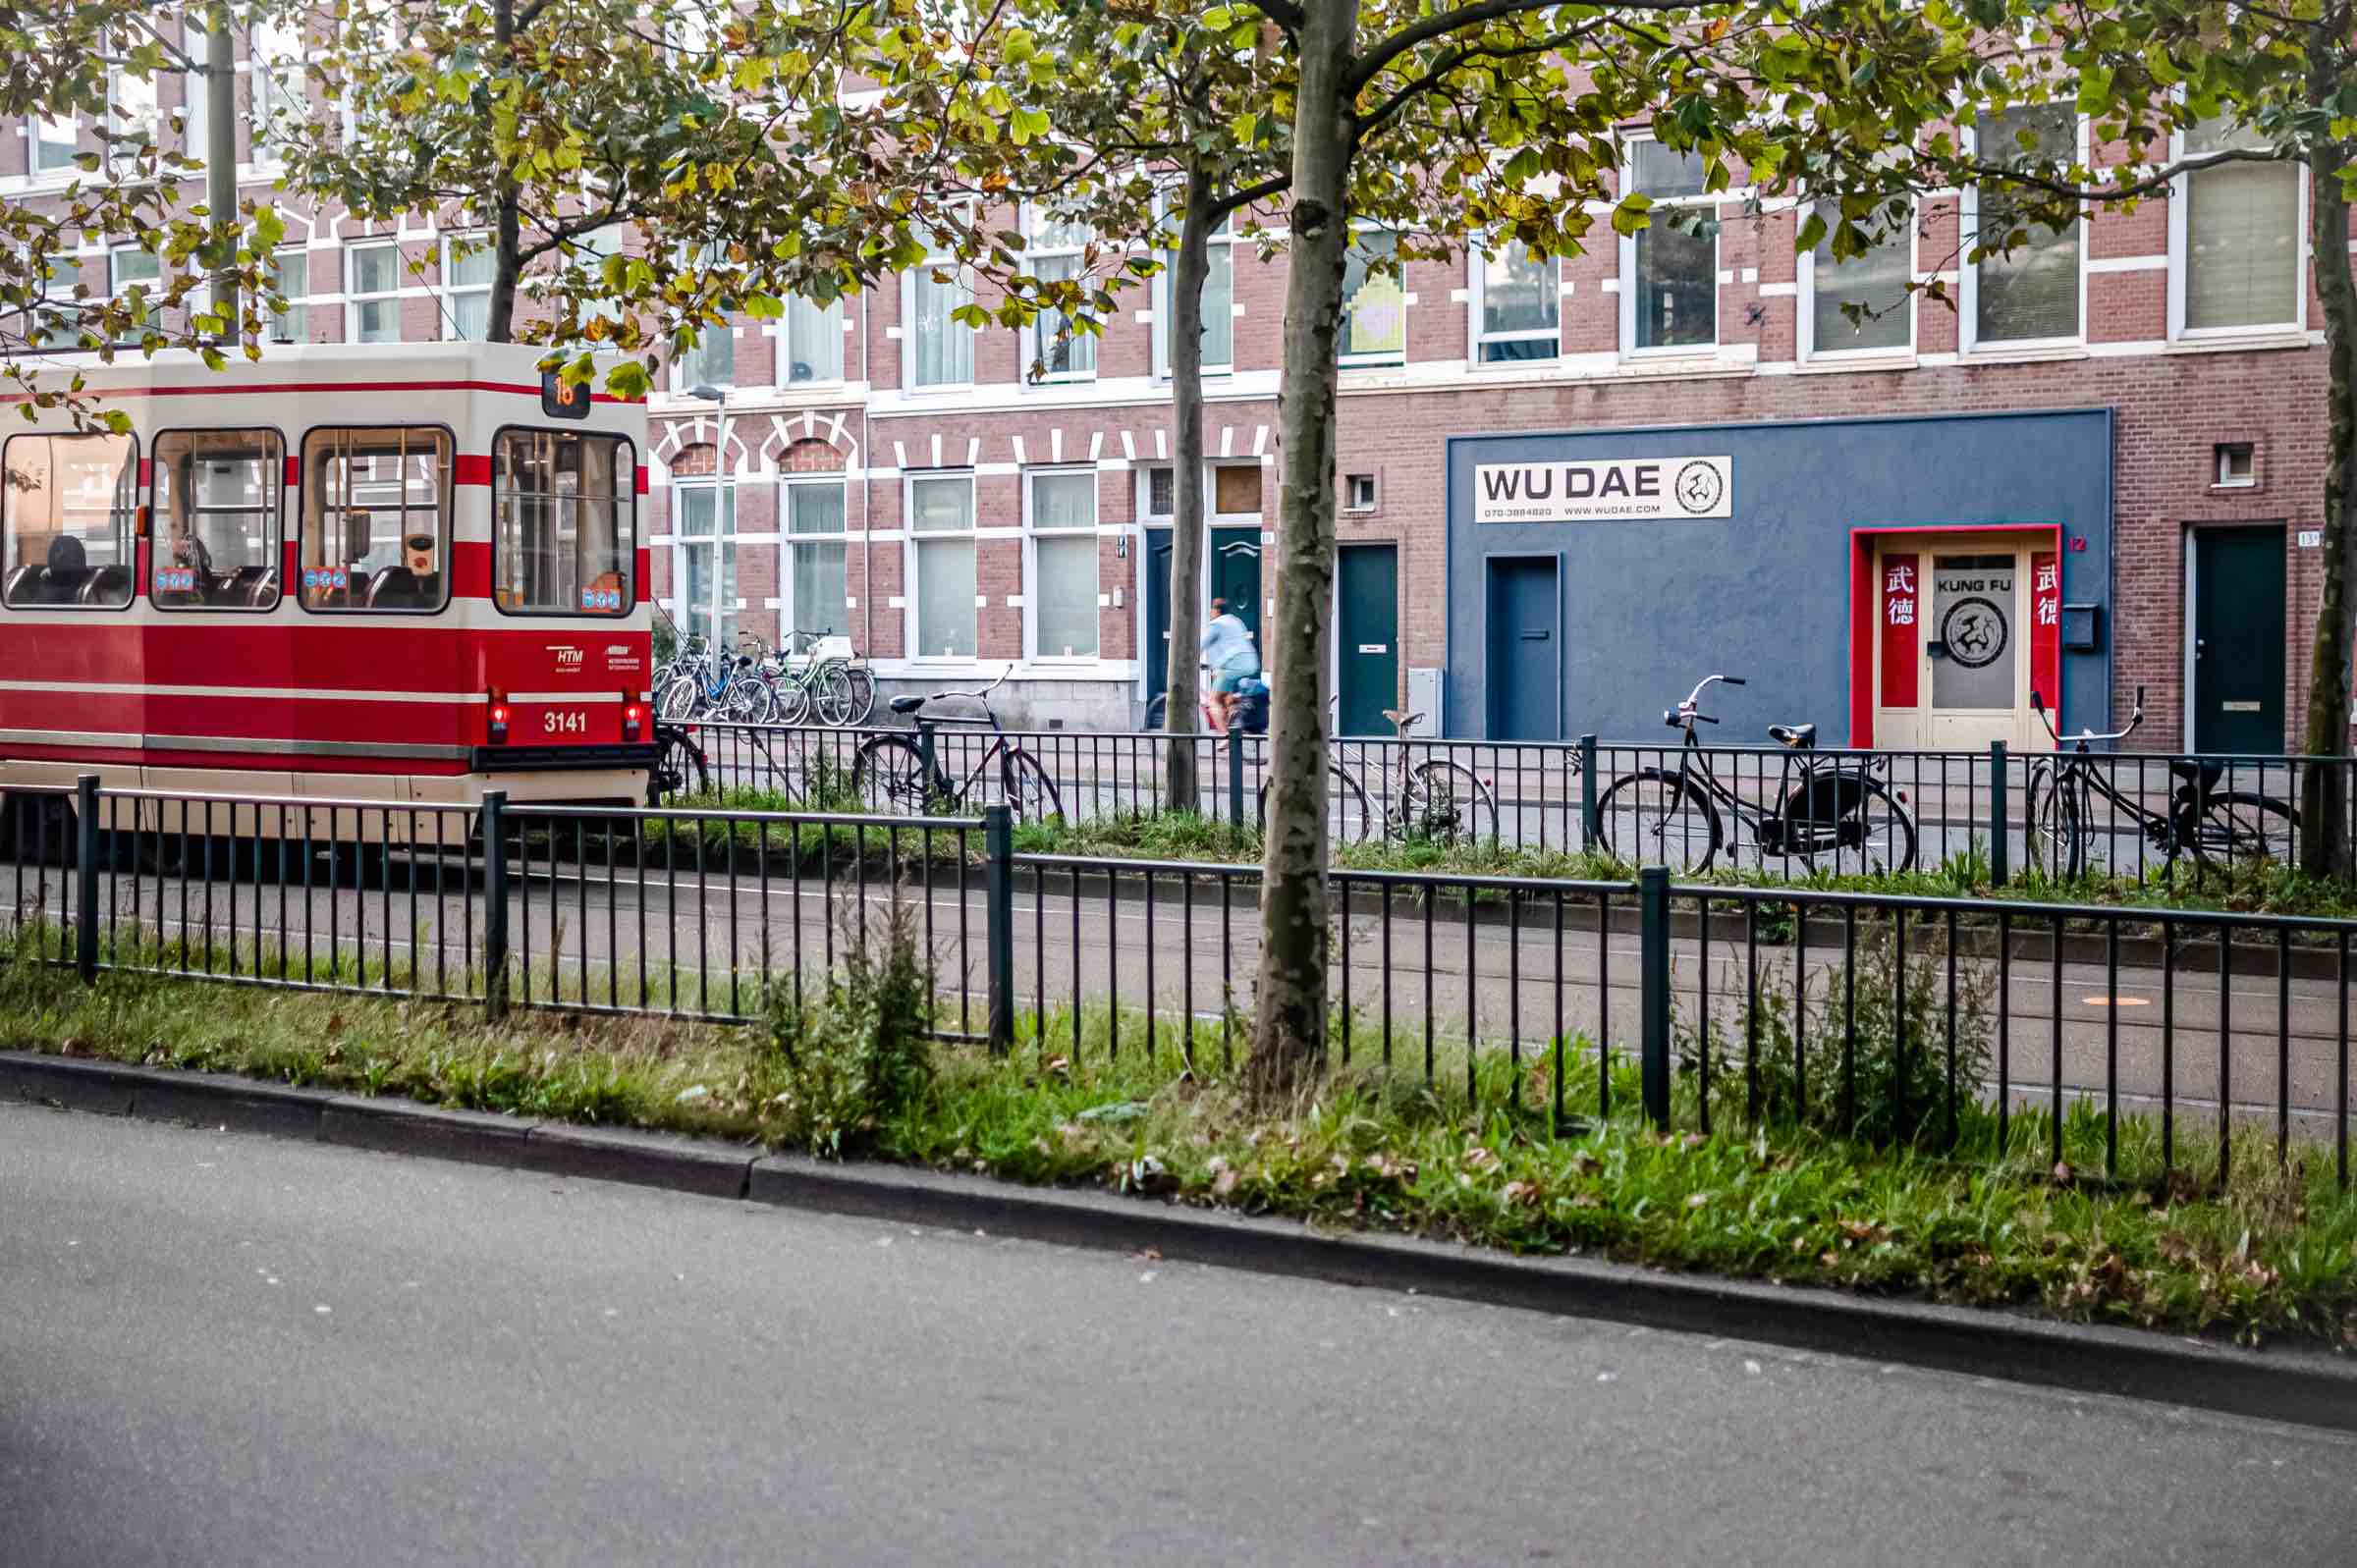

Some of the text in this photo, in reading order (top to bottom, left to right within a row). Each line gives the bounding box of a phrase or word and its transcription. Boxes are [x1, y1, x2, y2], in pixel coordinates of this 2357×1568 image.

[1483, 469, 1553, 501] WU
[1565, 464, 1660, 499] DAE
[2068, 536, 2087, 552] 12
[1938, 578, 2012, 592] KUNG FU
[557, 650, 583, 663] HTM
[544, 712, 586, 732] 3141
